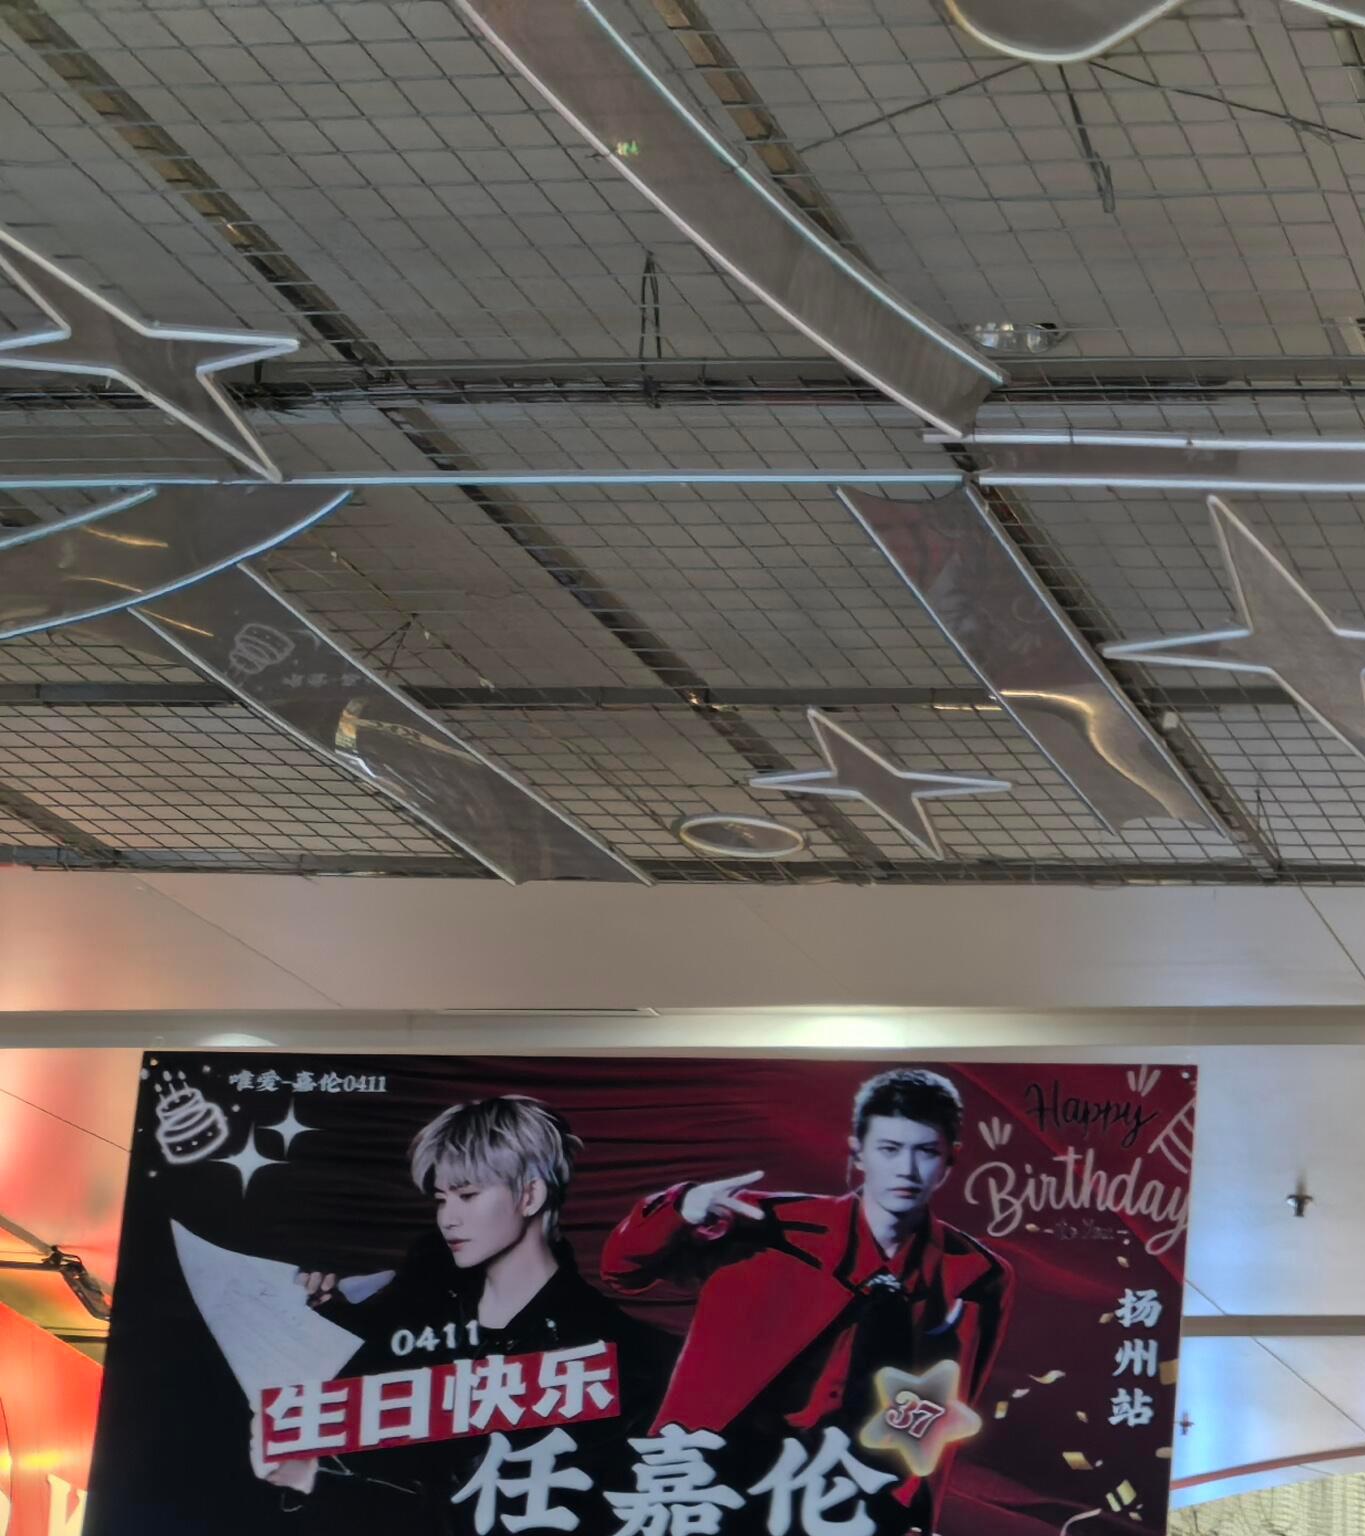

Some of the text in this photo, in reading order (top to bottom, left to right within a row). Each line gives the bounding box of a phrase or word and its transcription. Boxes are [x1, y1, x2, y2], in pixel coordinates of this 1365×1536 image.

[1025, 1081, 1158, 1147] Happy
[965, 1146, 1190, 1255] Birthday
[390, 1319, 480, 1356] 0411
[1108, 1288, 1163, 1427] 扬州站
[266, 1340, 614, 1456] 生日快乐
[885, 1391, 944, 1439] 37
